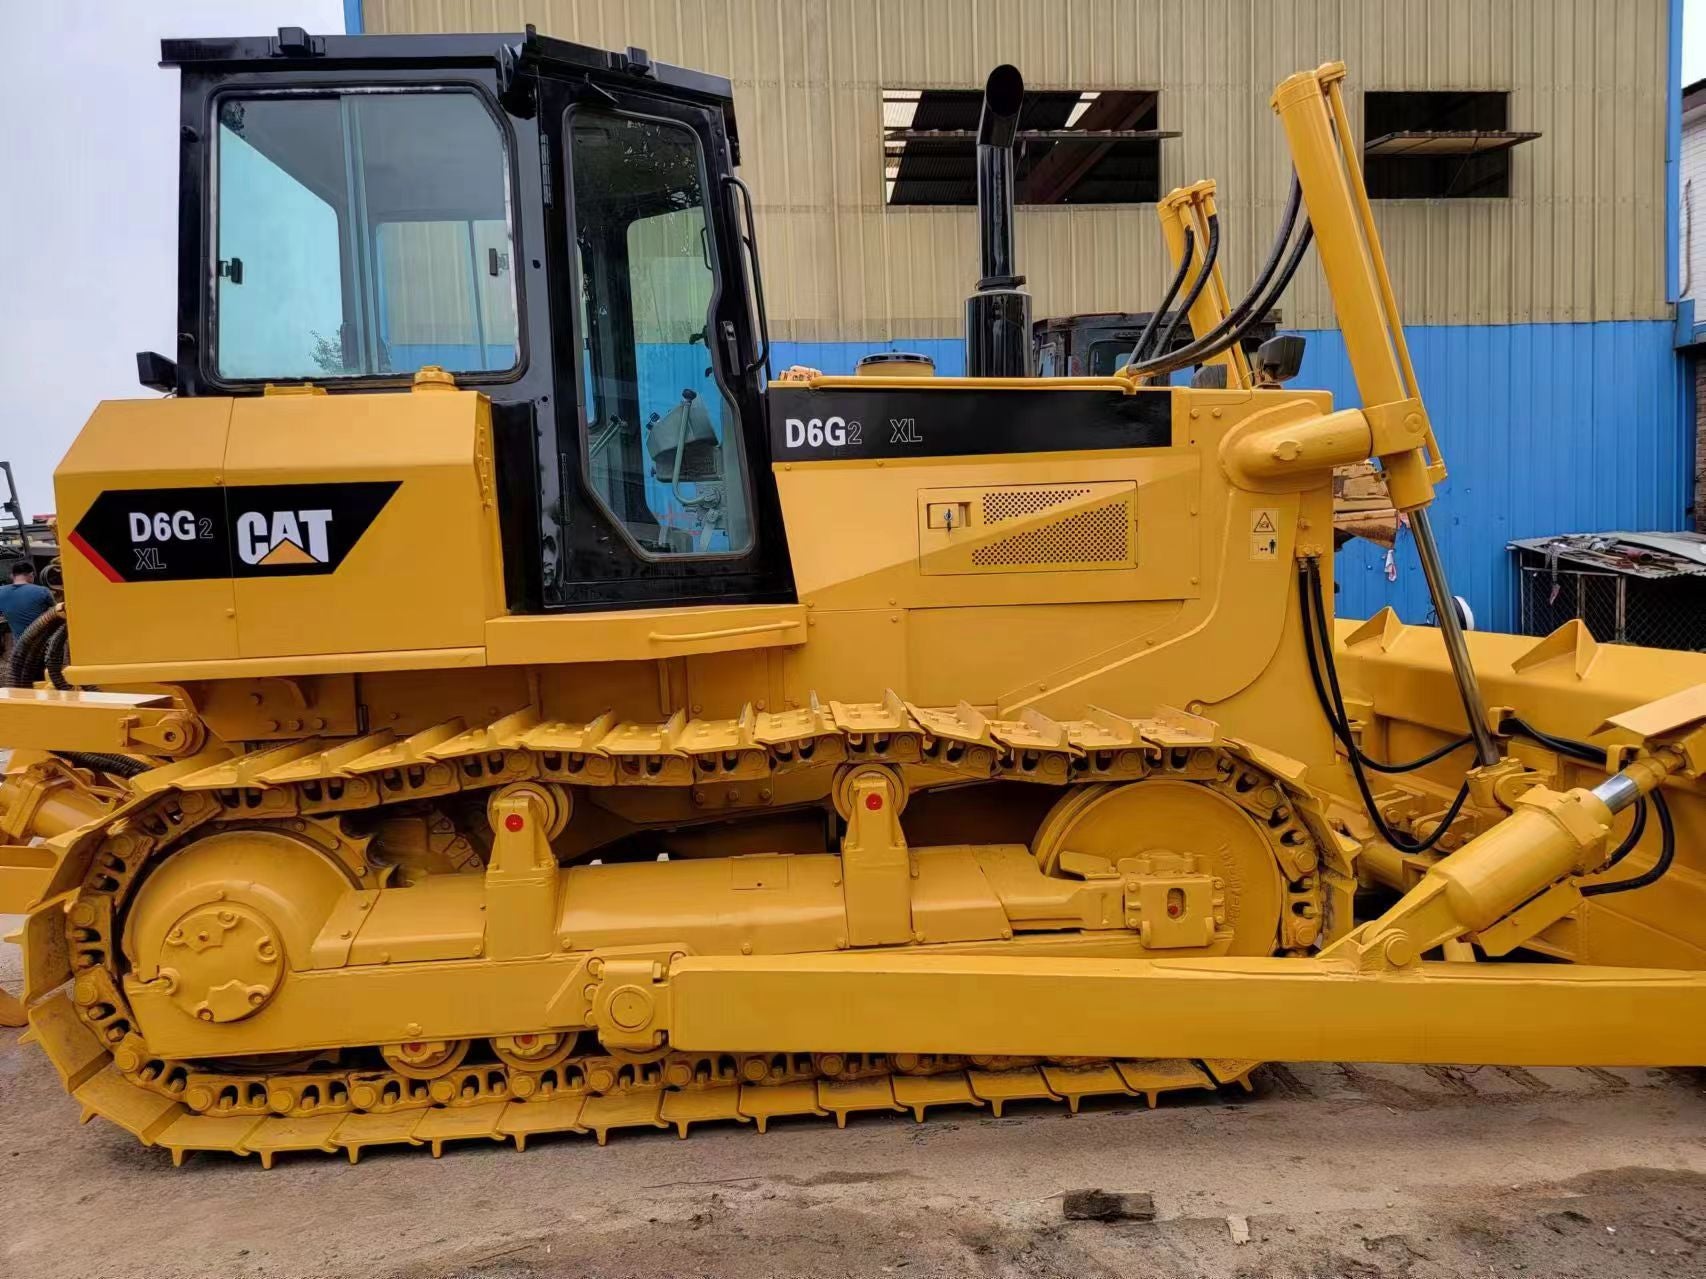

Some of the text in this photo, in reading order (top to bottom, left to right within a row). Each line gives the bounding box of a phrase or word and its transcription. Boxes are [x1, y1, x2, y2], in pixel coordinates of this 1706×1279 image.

[785, 416, 923, 448] D6G2 XL
[128, 510, 214, 542] D6G2
[236, 508, 333, 565] CAT
[133, 547, 167, 570] XL
